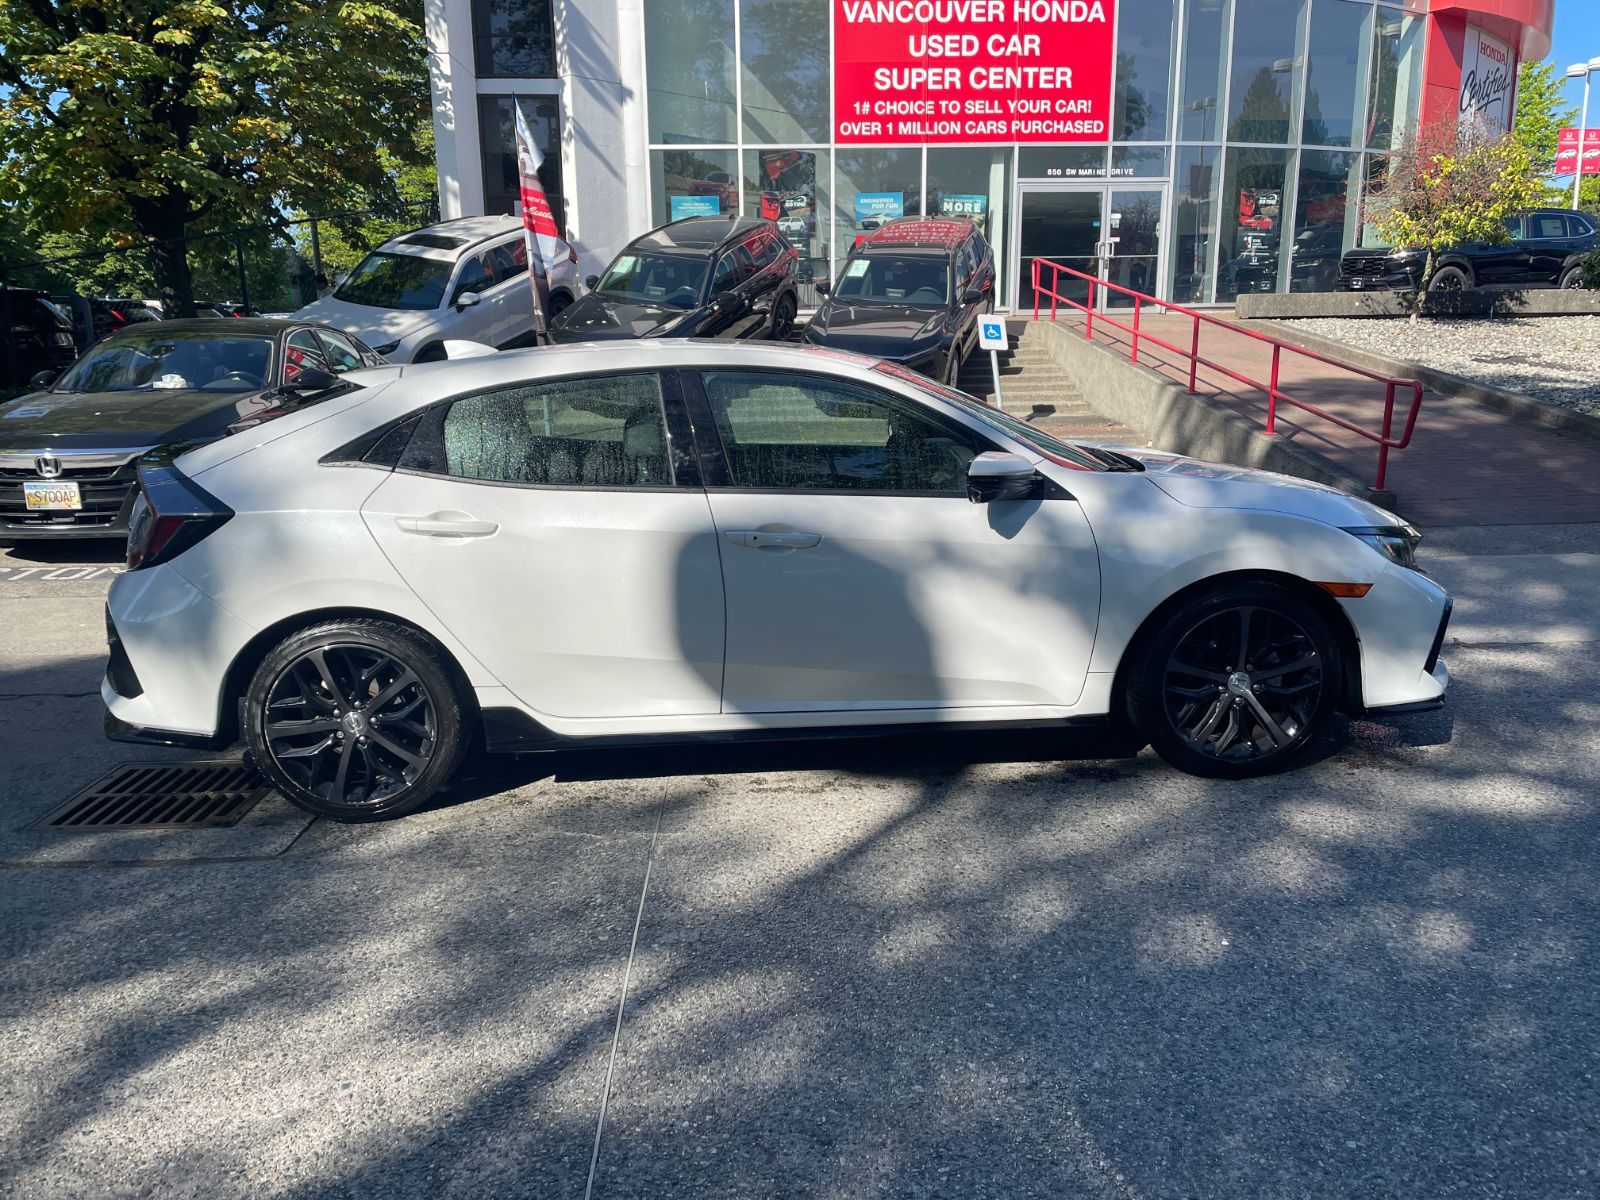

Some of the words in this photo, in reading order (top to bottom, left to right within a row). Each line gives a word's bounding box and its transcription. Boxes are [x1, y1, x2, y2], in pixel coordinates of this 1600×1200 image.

[842, 0, 1005, 23] VANCOUVER
[1013, 0, 1106, 23] HONDA
[908, 34, 980, 57] USED
[986, 33, 1041, 57] CAR
[1480, 42, 1507, 66] HONDA
[874, 67, 962, 91] SUPER
[969, 66, 1073, 90] CENTER
[1460, 62, 1511, 113] Certified
[853, 101, 871, 115] 1#
[874, 100, 935, 115] CHOICE
[939, 100, 960, 114] TO
[964, 100, 1003, 114] SELL
[1007, 99, 1052, 114] YOUR
[1055, 99, 1092, 114] CAR!
[840, 121, 882, 136] OVER
[885, 121, 893, 135] 1
[898, 121, 961, 135] MILLION
[964, 120, 1008, 135] CARS
[1011, 120, 1105, 134] PURCHASED
[1047, 168, 1062, 176] 850
[943, 202, 982, 213] MORE
